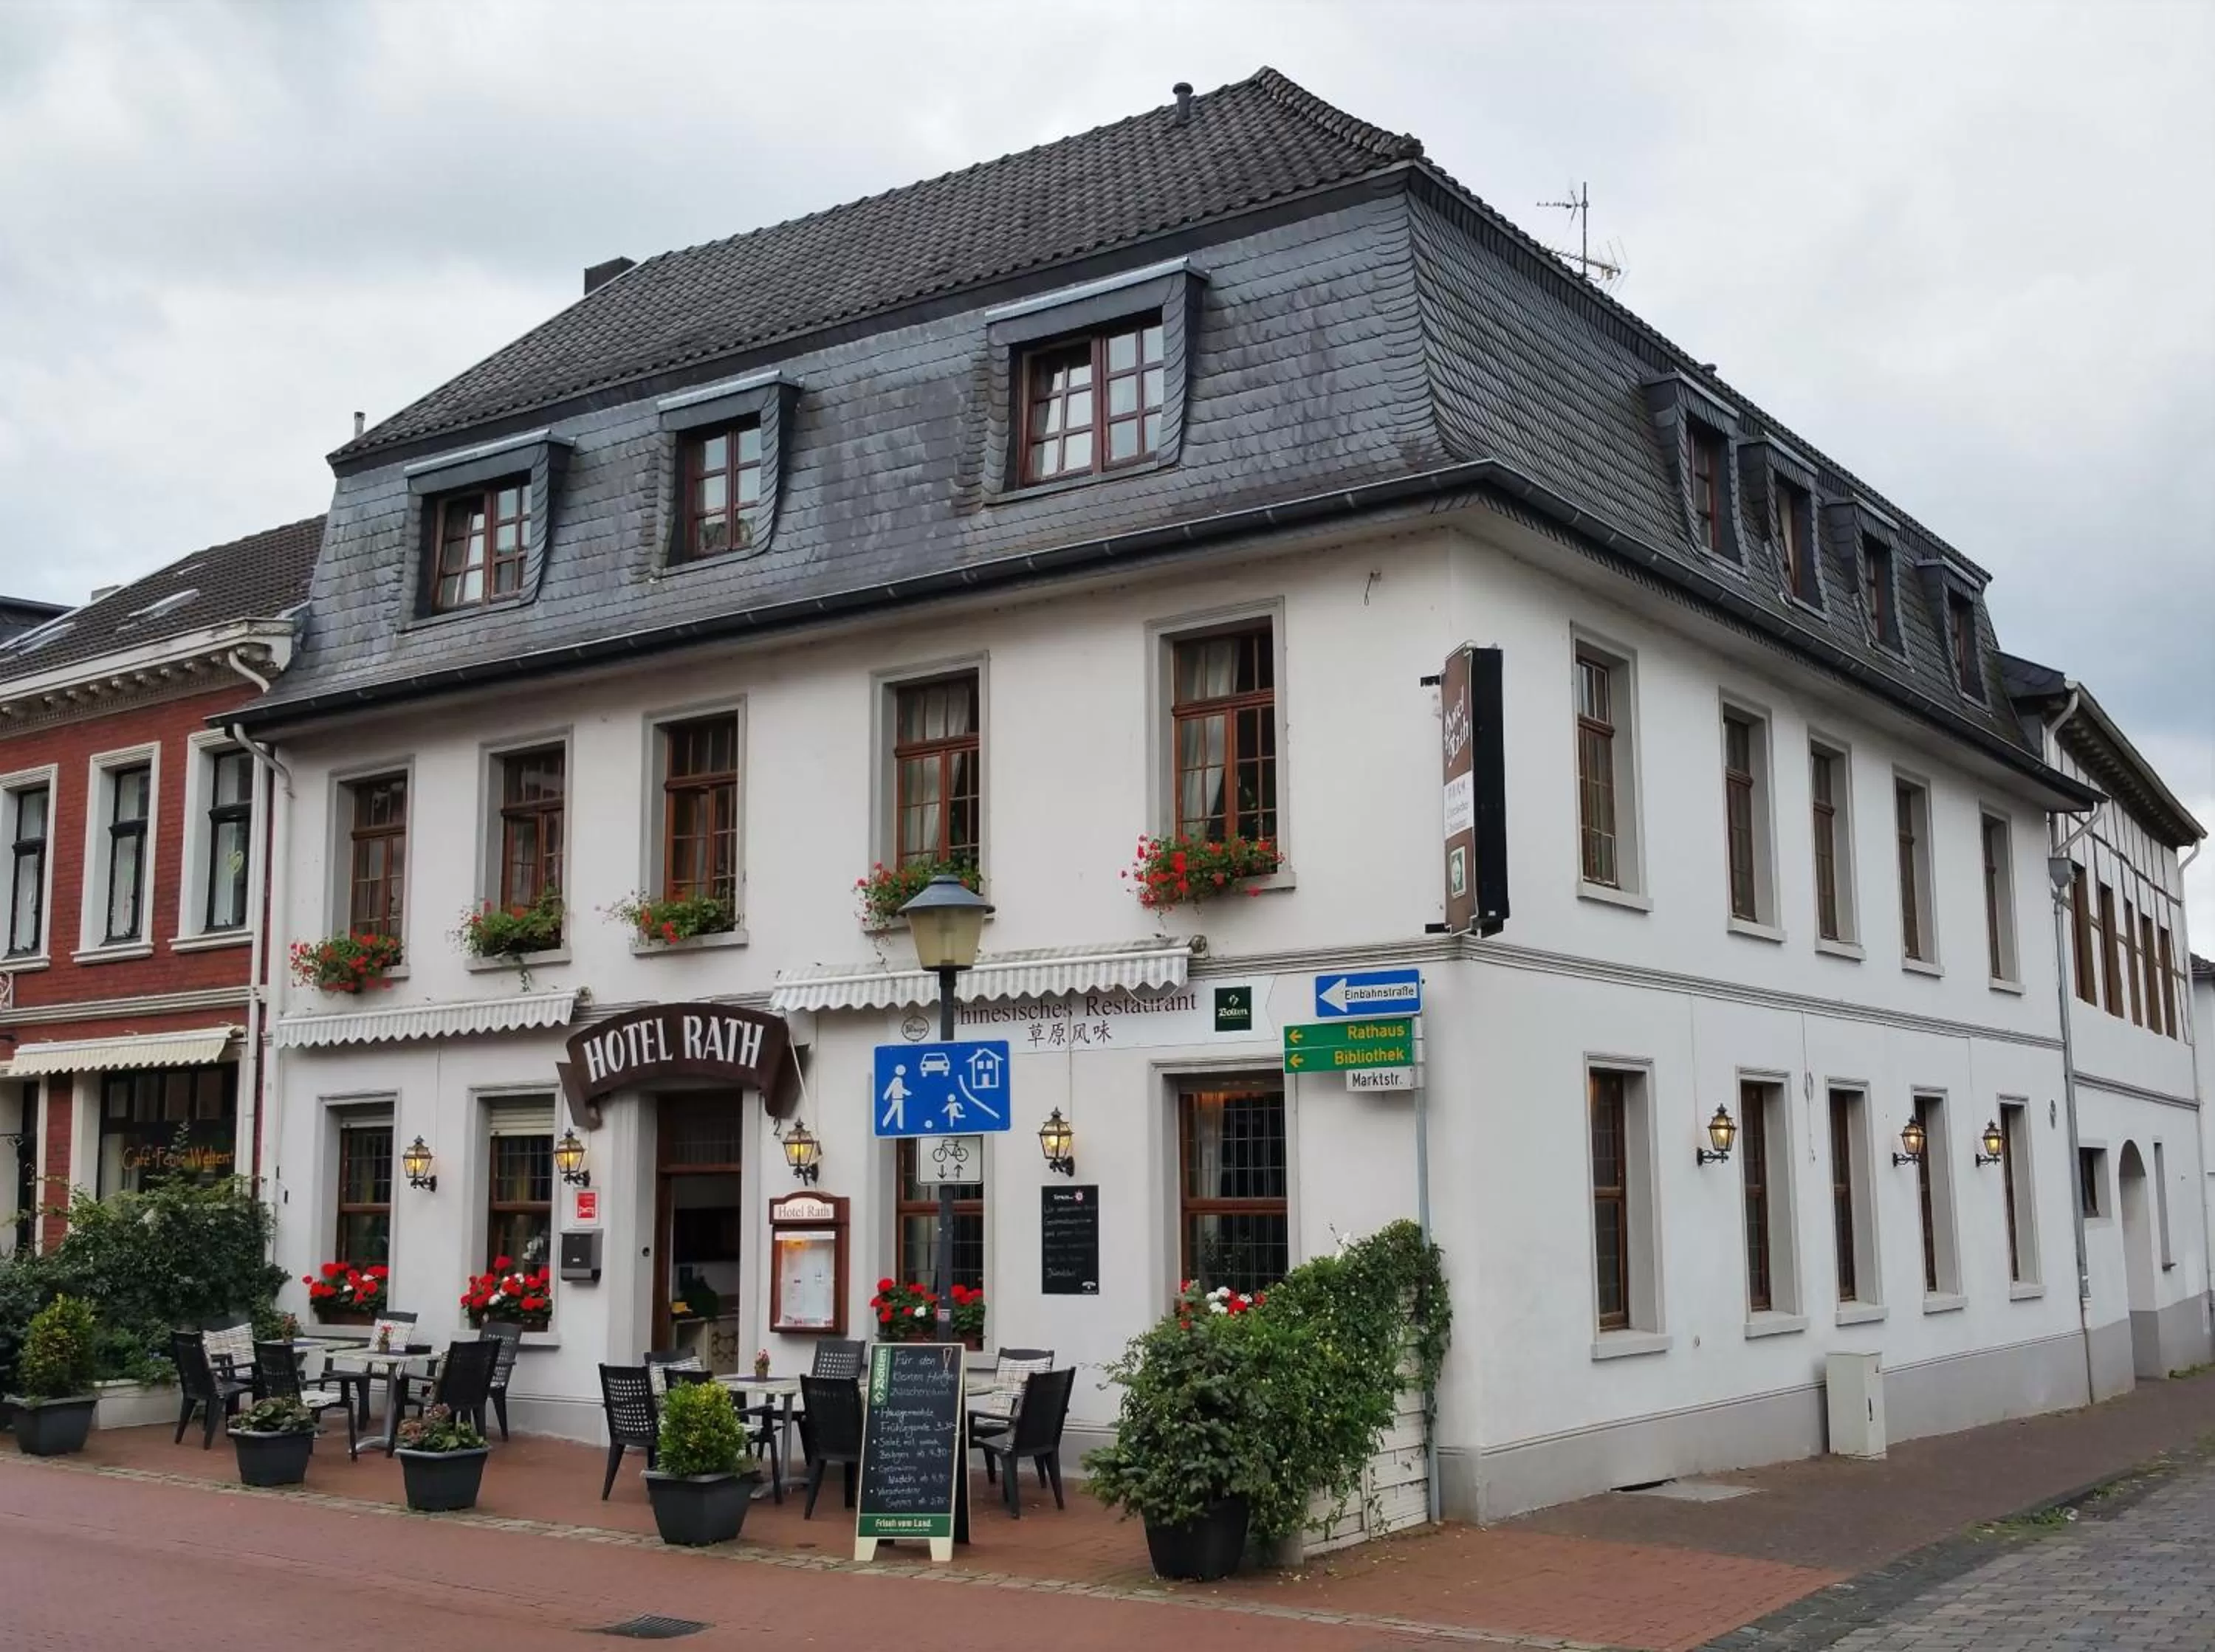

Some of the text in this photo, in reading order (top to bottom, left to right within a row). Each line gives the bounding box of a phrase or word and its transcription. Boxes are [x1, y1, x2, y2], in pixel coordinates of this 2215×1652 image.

[1344, 986, 1415, 1000] Einbahnstraße
[953, 991, 1198, 1025] hinesisches Restaurant
[1027, 1019, 1112, 1048] 草原风味
[1347, 1024, 1405, 1040] Rathaus
[583, 1015, 765, 1084] HOTEL RATH
[1334, 1046, 1405, 1065] Bibliothek
[1352, 1073, 1404, 1087] Marktstr.
[773, 1118, 782, 1136] 2
[777, 1205, 831, 1218] Hotel Rath
[875, 1518, 896, 1528] Frisch
